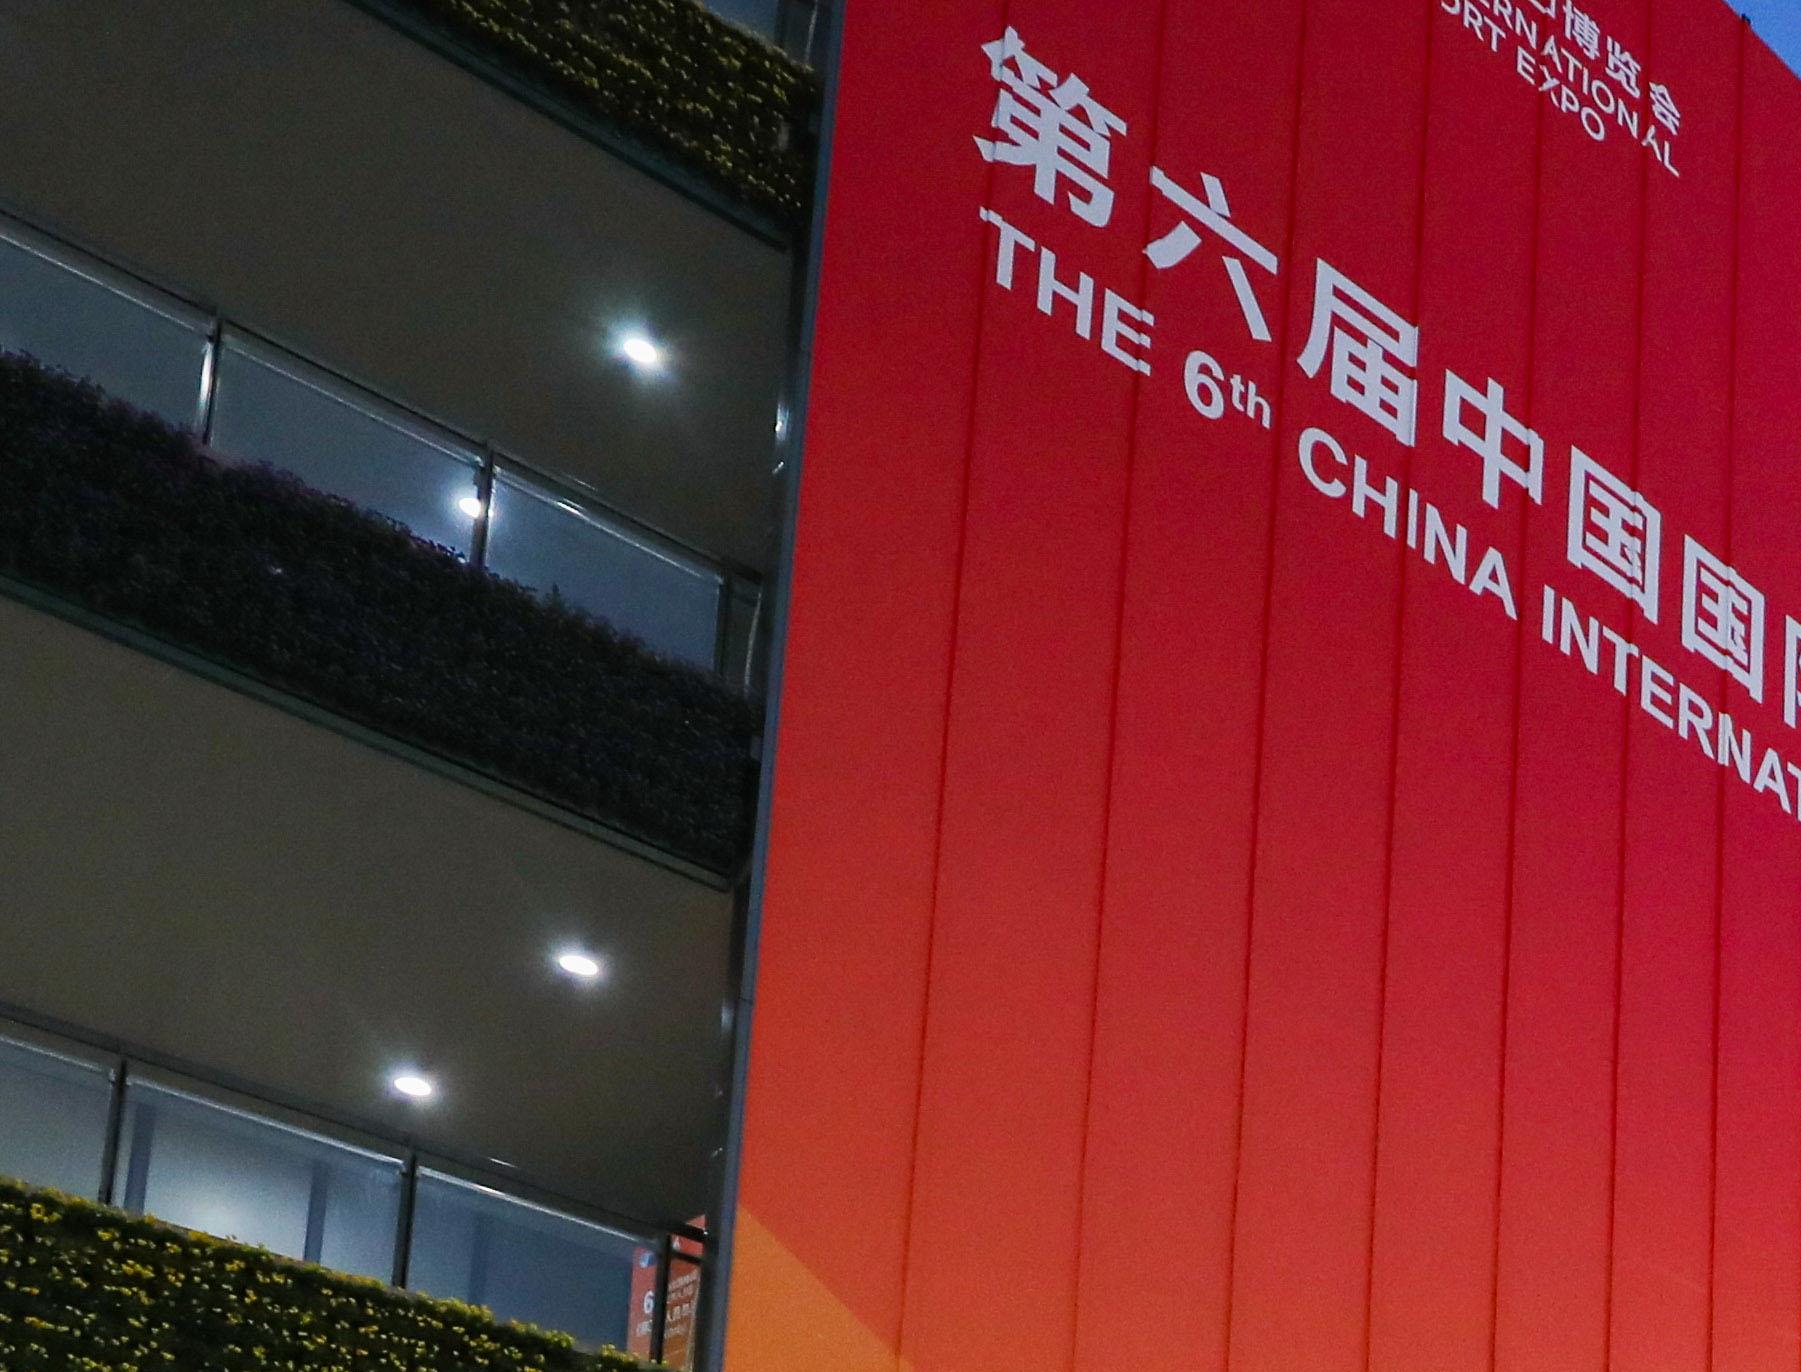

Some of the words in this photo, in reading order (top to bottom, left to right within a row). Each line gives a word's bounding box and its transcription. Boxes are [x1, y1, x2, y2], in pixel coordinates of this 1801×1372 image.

[1478, 0, 1680, 178] RNATIONAL
[1516, 45, 1605, 142] EXPO
[979, 207, 1155, 377] THE
[1183, 348, 1272, 430] 6th
[1298, 427, 1518, 622] CHINA
